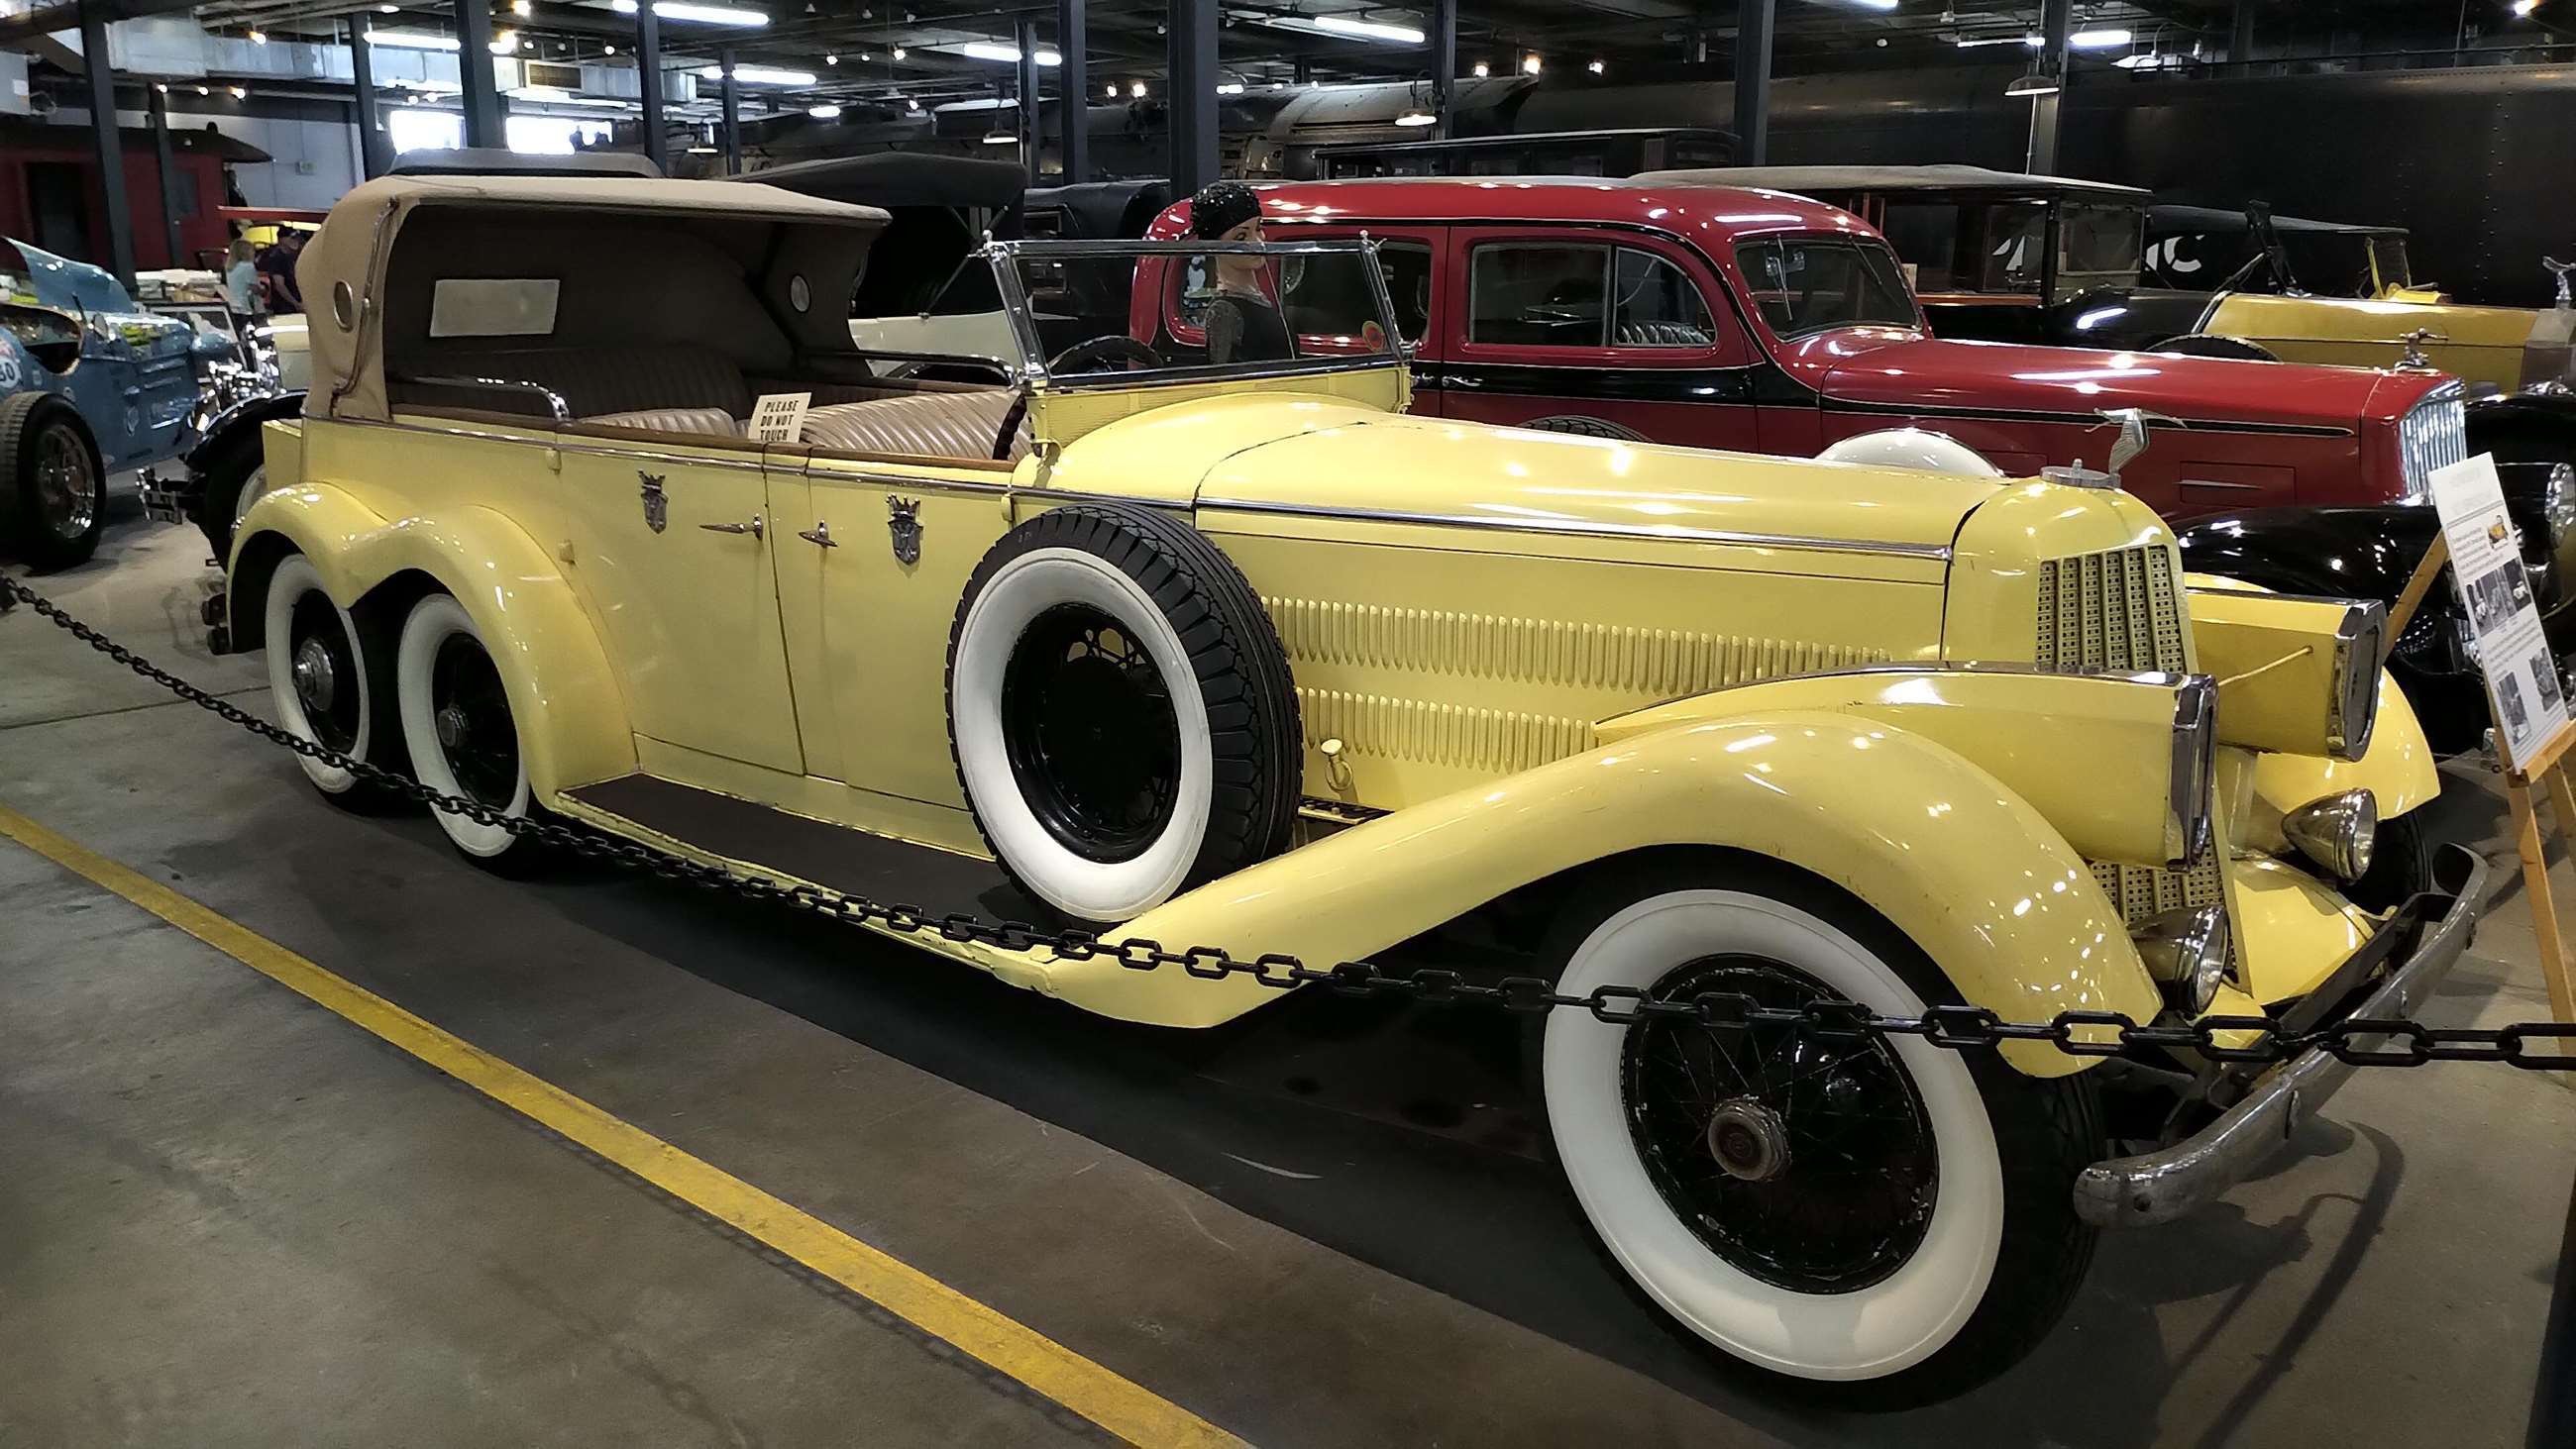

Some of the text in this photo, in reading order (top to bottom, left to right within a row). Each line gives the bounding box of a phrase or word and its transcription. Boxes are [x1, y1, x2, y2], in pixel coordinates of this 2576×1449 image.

[764, 400, 799, 413] PLEASE
[760, 414, 794, 427] DO NOT
[760, 429, 789, 442] TOUCH
